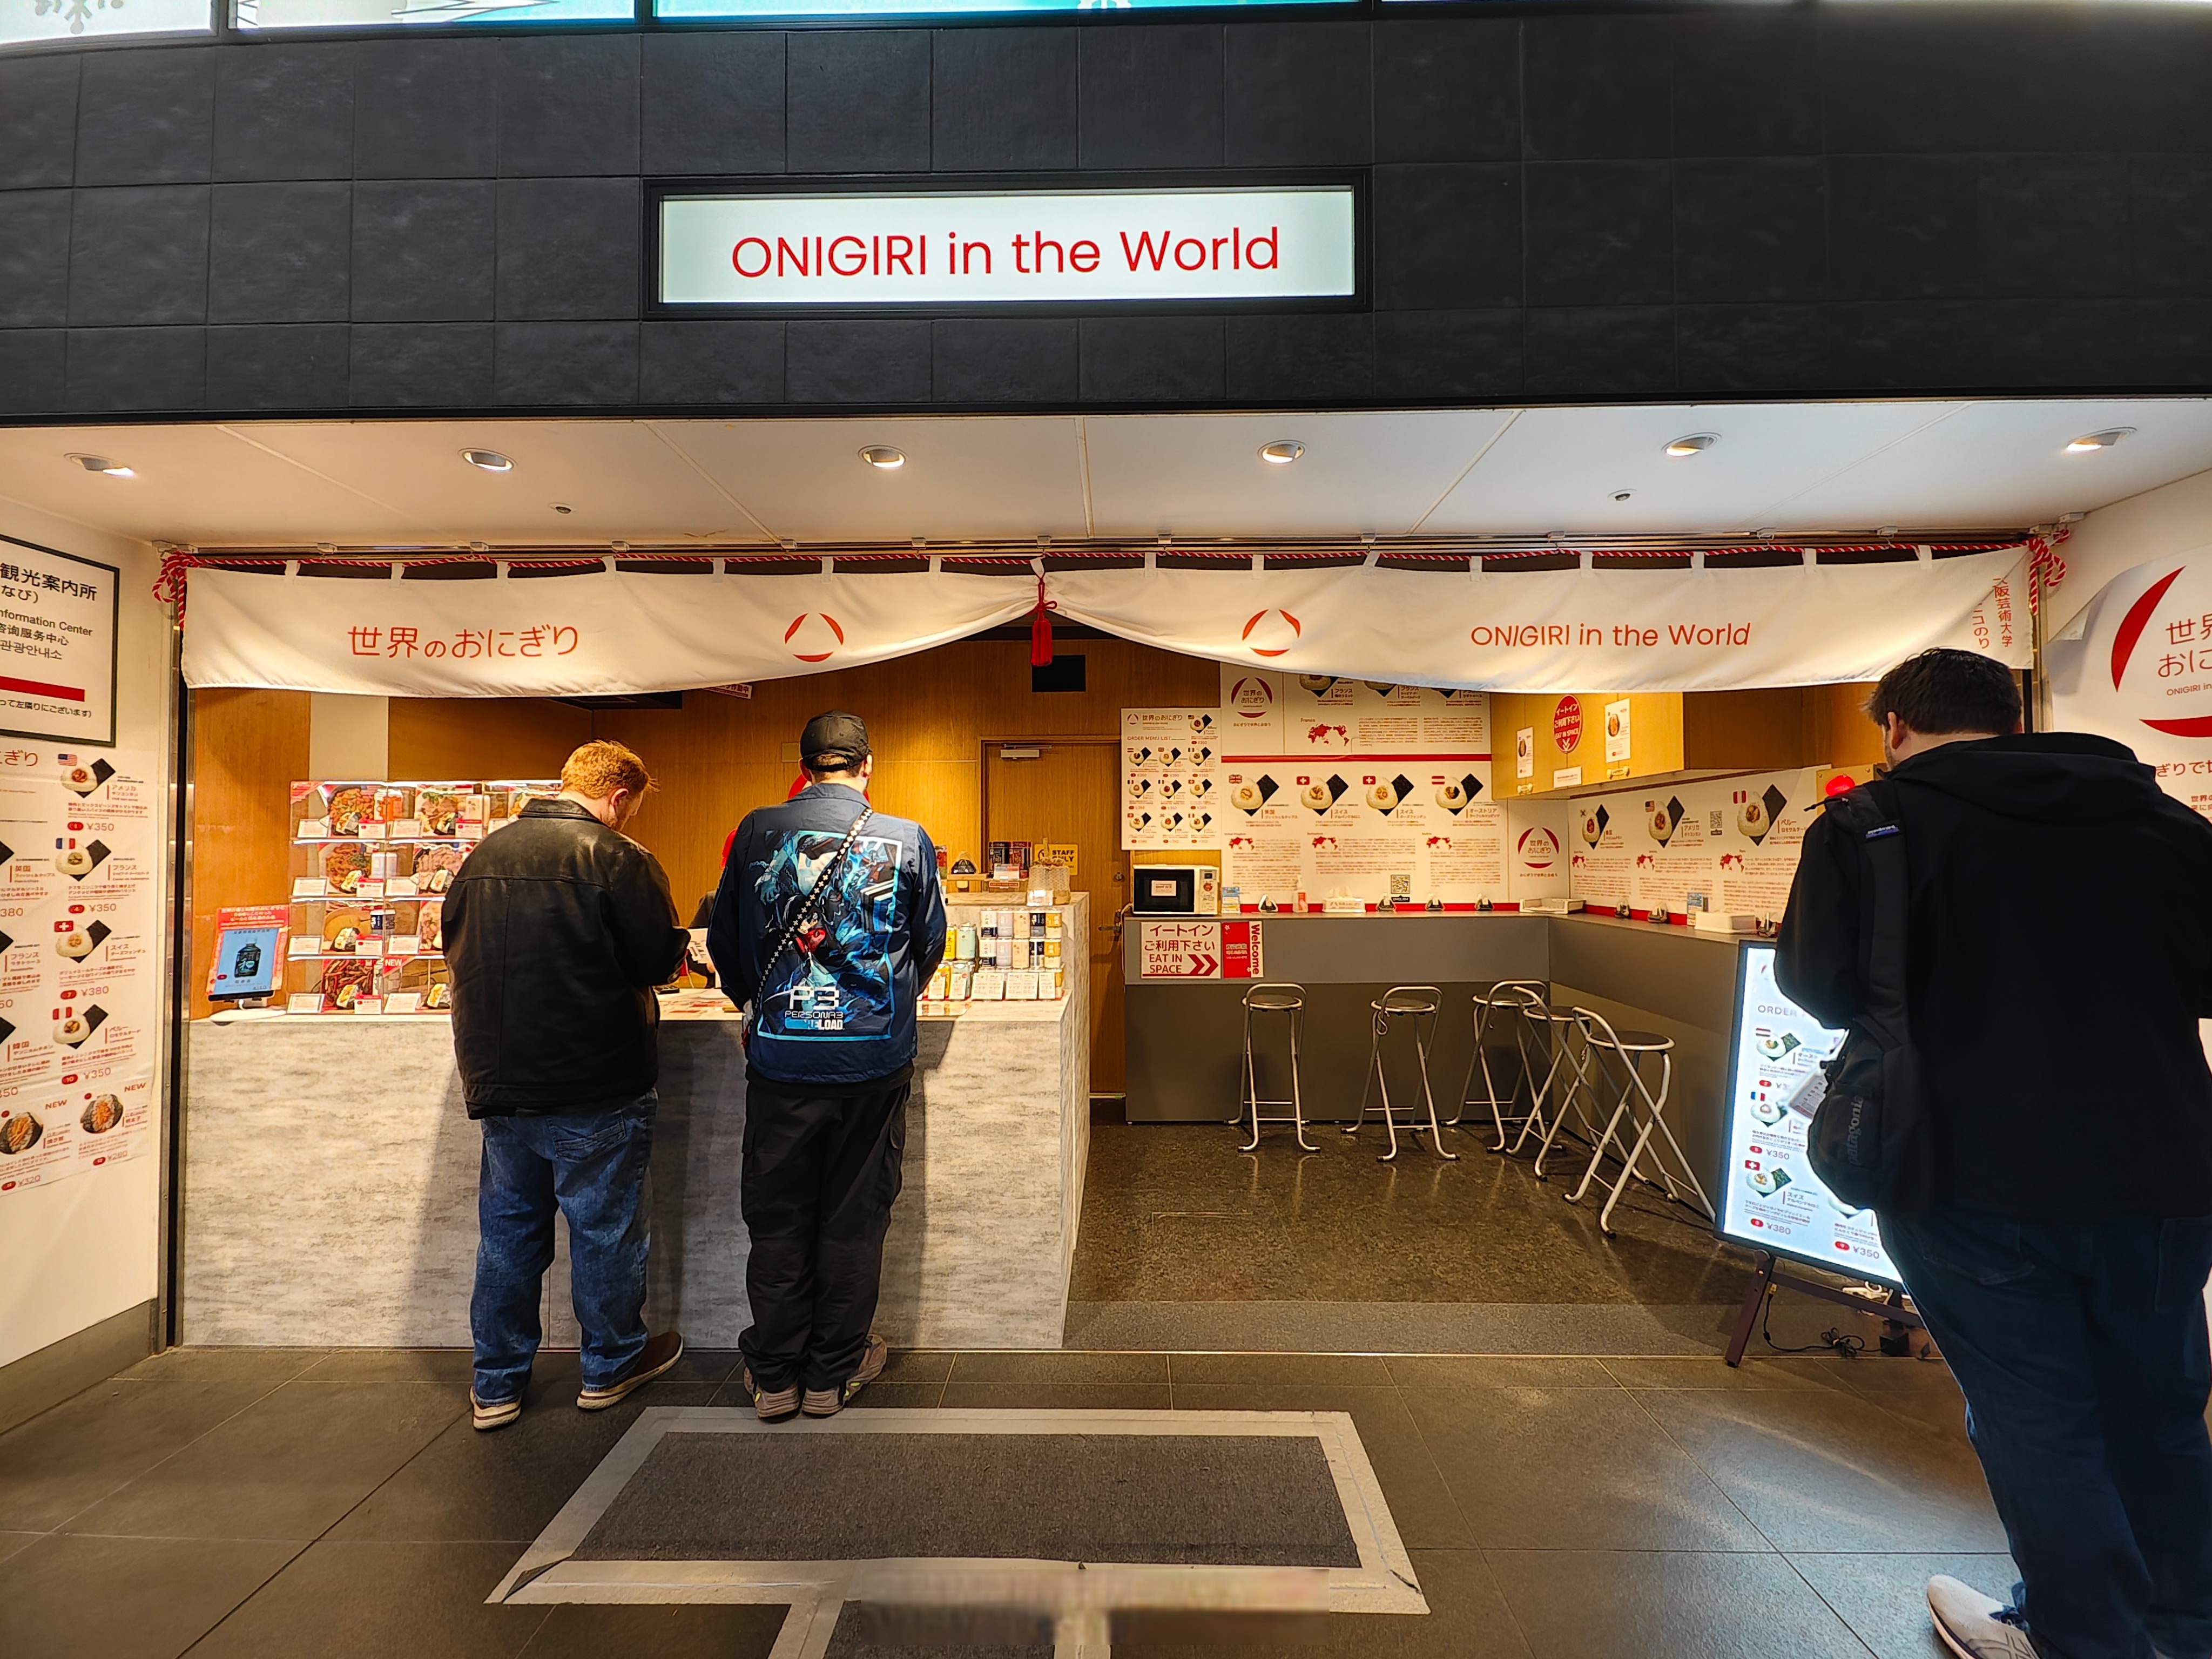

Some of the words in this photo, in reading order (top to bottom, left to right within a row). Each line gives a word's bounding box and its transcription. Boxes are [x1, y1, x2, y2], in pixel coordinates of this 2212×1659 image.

[732, 234, 927, 278] ONIGIRI
[948, 231, 992, 275] in
[1011, 230, 1101, 274] the
[1118, 225, 1279, 273] World
[0, 563, 97, 601] 観光案内所
[59, 621, 93, 637] Center
[1471, 624, 1570, 648] ONIGIRI
[1579, 623, 1602, 646] in
[1612, 624, 1658, 647] the
[1667, 622, 1751, 646] World
[347, 623, 579, 658] 世界のおにぎり
[1, 639, 63, 660] 관광안내소
[2157, 649, 2212, 678] おに
[2166, 684, 2201, 696] ONIGIRI
[1240, 696, 1265, 704] おにぎり
[1556, 703, 1578, 717] イートイン
[86, 822, 114, 832] ¥350
[89, 903, 117, 913] ¥350
[1150, 923, 1214, 937] イートイン
[1144, 940, 1216, 952] ご利用下さい
[1251, 923, 1261, 975] Welcome
[11, 952, 39, 960] フランス
[385, 958, 402, 967] NEW
[1149, 954, 1169, 963] EAT
[1172, 954, 1183, 963] IN
[1149, 965, 1182, 974] SPACE
[81, 986, 109, 997] ¥380
[789, 985, 840, 1010] P3
[1757, 1004, 1797, 1016] ORDER
[83, 1067, 111, 1080] ¥350
[124, 1082, 147, 1092] NEW
[44, 1099, 68, 1110] NEW
[1766, 1148, 1790, 1161] ¥350
[1787, 1191, 1804, 1200] スイス
[1766, 1222, 1791, 1235] ¥380
[1852, 1245, 1880, 1259] ¥350
